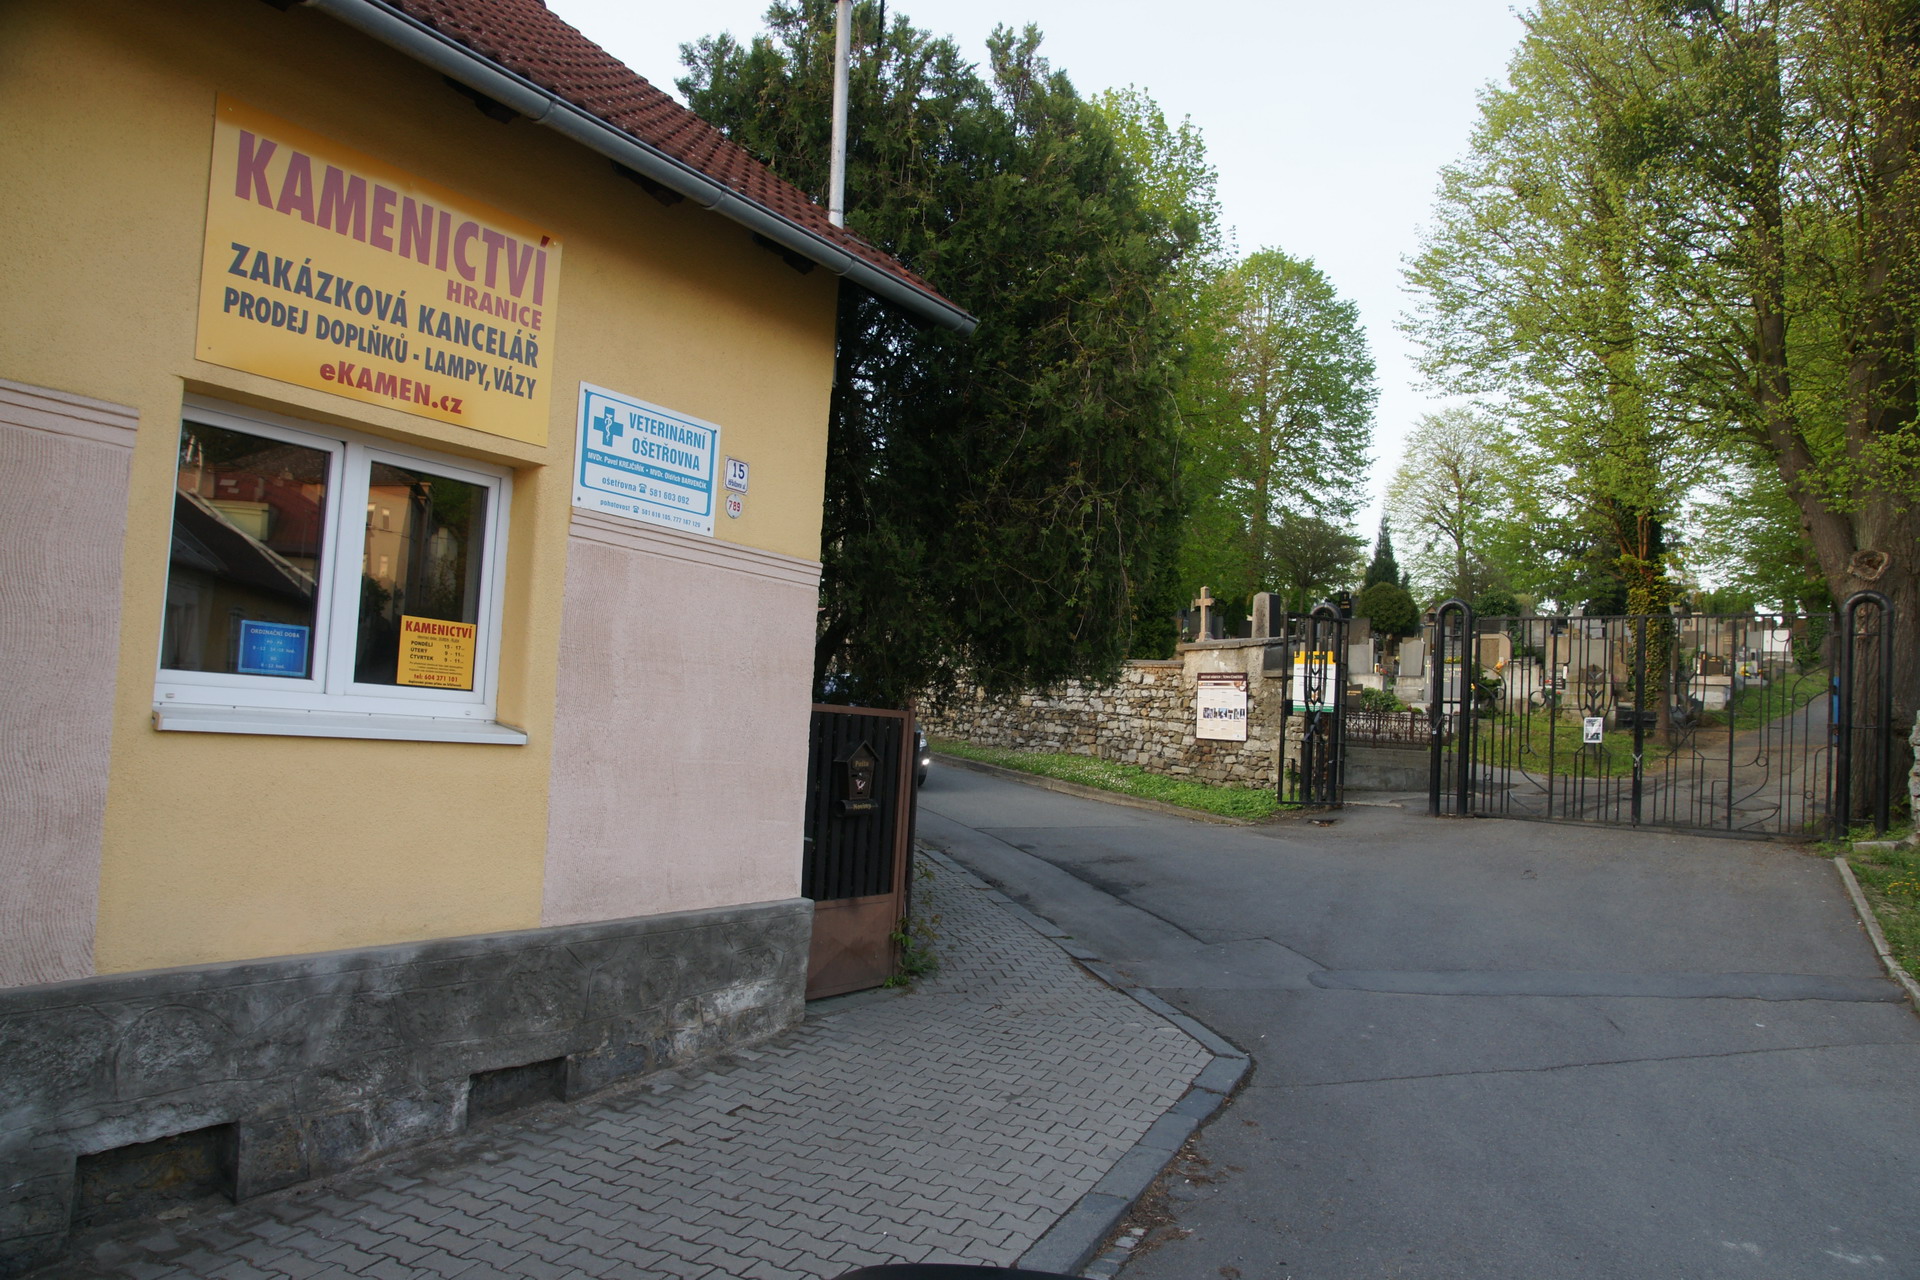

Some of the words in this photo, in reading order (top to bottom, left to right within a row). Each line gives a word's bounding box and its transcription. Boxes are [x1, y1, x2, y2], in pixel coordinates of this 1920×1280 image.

[235, 129, 550, 307] KAMENICTVÍ
[227, 242, 408, 328] ZAKÁZKOVÁ
[418, 304, 539, 368] KANCELÁŘ
[446, 279, 542, 331] HRANICE
[223, 286, 308, 334] PRODEJ
[315, 313, 408, 364] DOPLŇKŮ
[320, 361, 462, 414] eKAMEN.cz
[629, 411, 707, 450] VETERINÁRNÍ
[604, 456, 618, 467] Pavel
[632, 437, 700, 471] OŠETŘOVNA
[733, 462, 745, 480] 15
[602, 477, 637, 492] ošetřovna
[649, 488, 662, 498] 581
[663, 491, 676, 502] 603
[677, 495, 690, 505] 092
[600, 499, 631, 512] pohotovost
[728, 499, 741, 512] 789
[250, 628, 283, 637] ORDINAČNÍ
[405, 620, 473, 639] KAMENICTVÍ
[410, 653, 434, 661] ČTVRTEK
